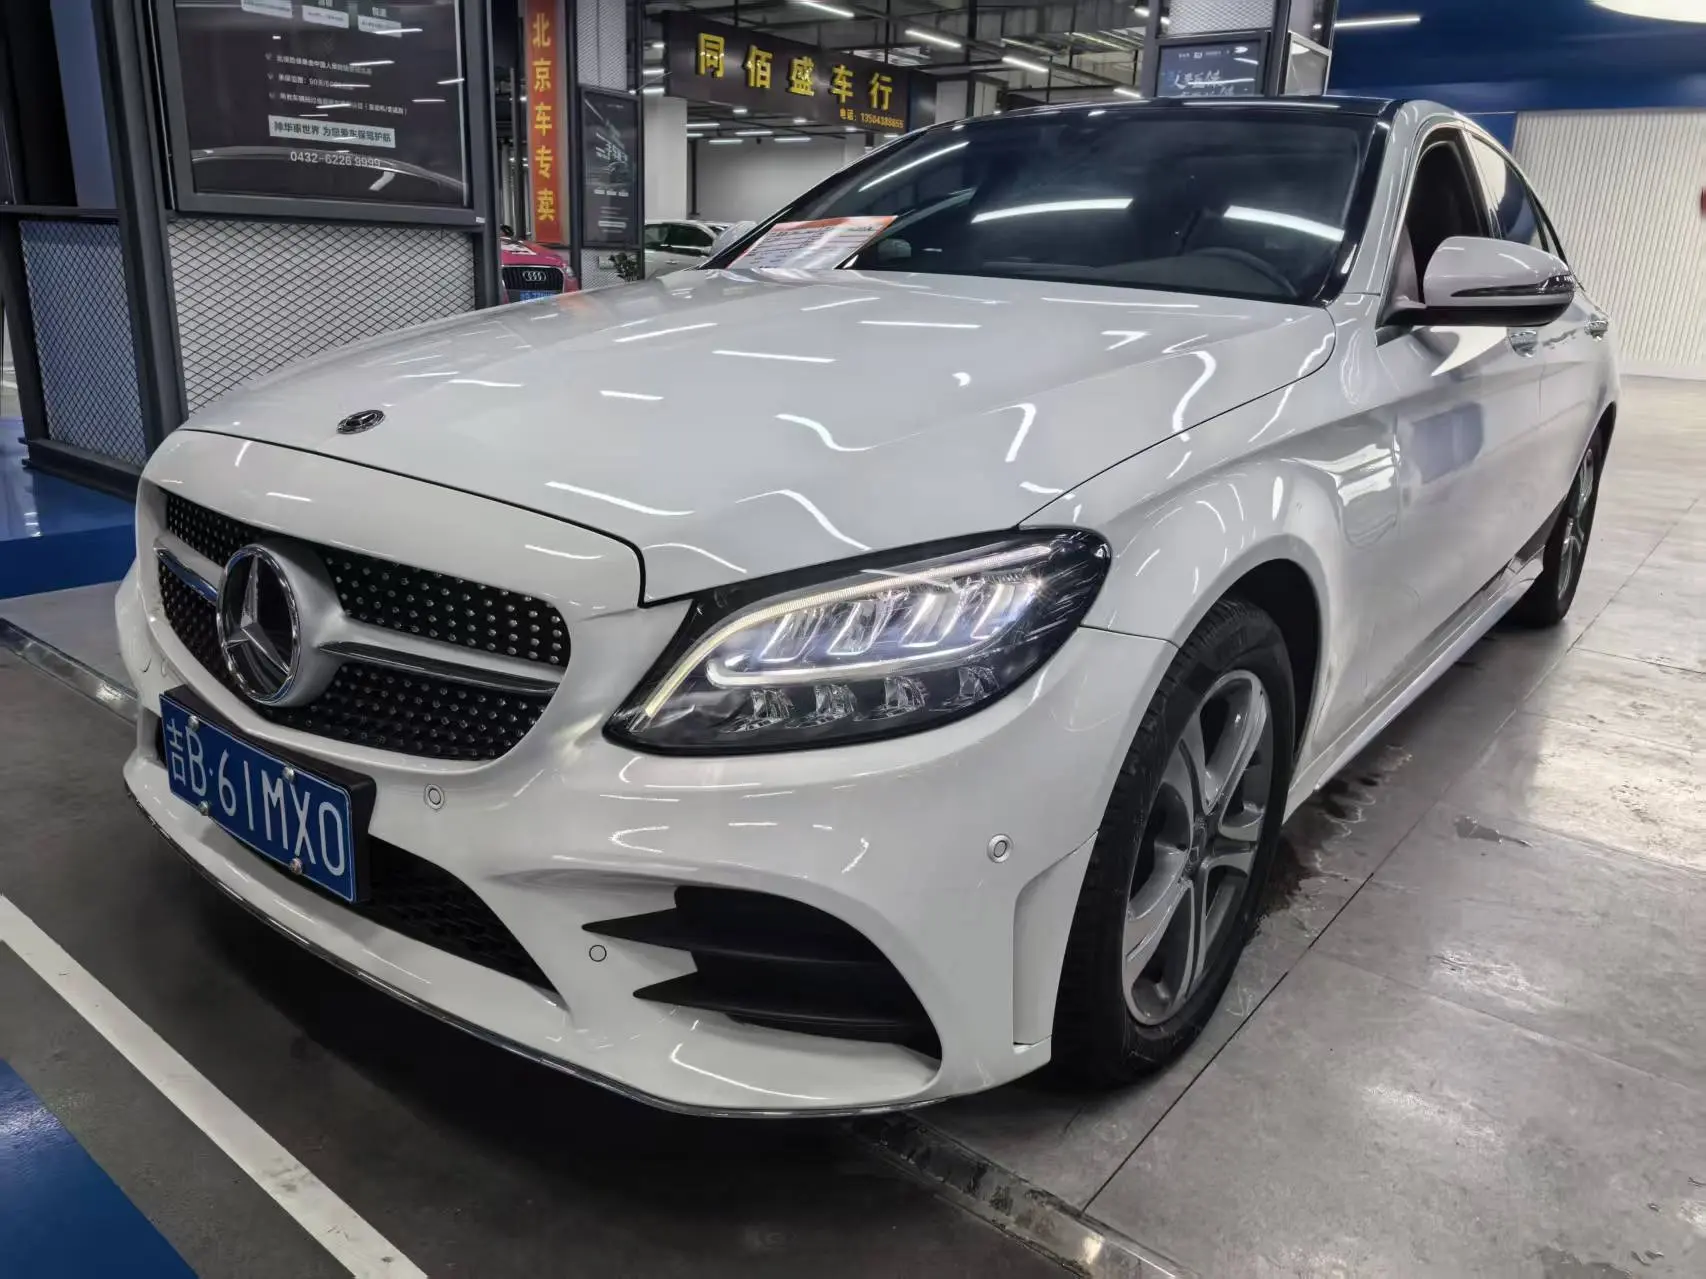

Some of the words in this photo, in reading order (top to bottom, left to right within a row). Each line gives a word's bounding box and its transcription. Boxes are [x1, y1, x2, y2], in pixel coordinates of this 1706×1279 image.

[531, 12, 556, 222] 北京车专卖
[697, 32, 893, 111] 同佰盛车行
